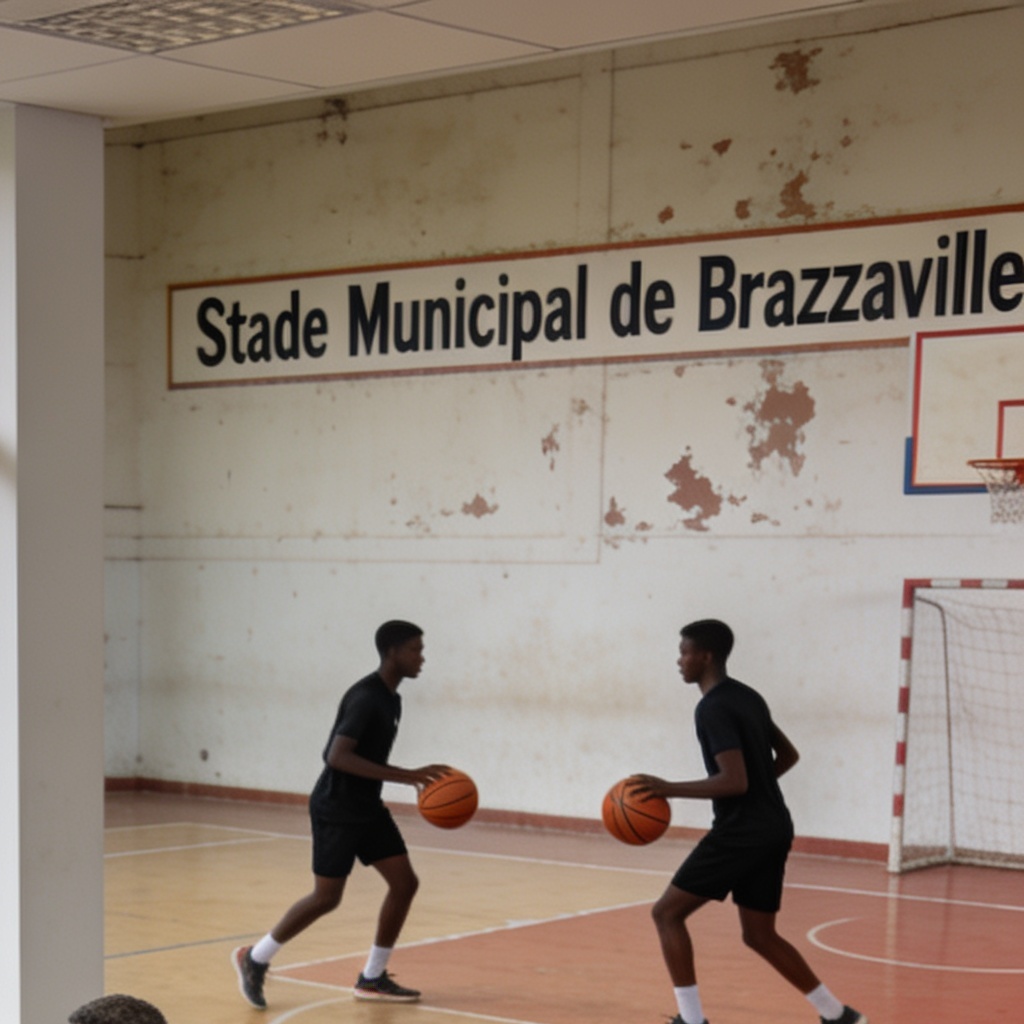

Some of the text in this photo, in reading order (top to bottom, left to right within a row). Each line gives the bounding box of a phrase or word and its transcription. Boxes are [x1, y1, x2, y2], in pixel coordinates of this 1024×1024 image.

[196, 229, 1024, 367] Stade Municipal de Brazzaville
